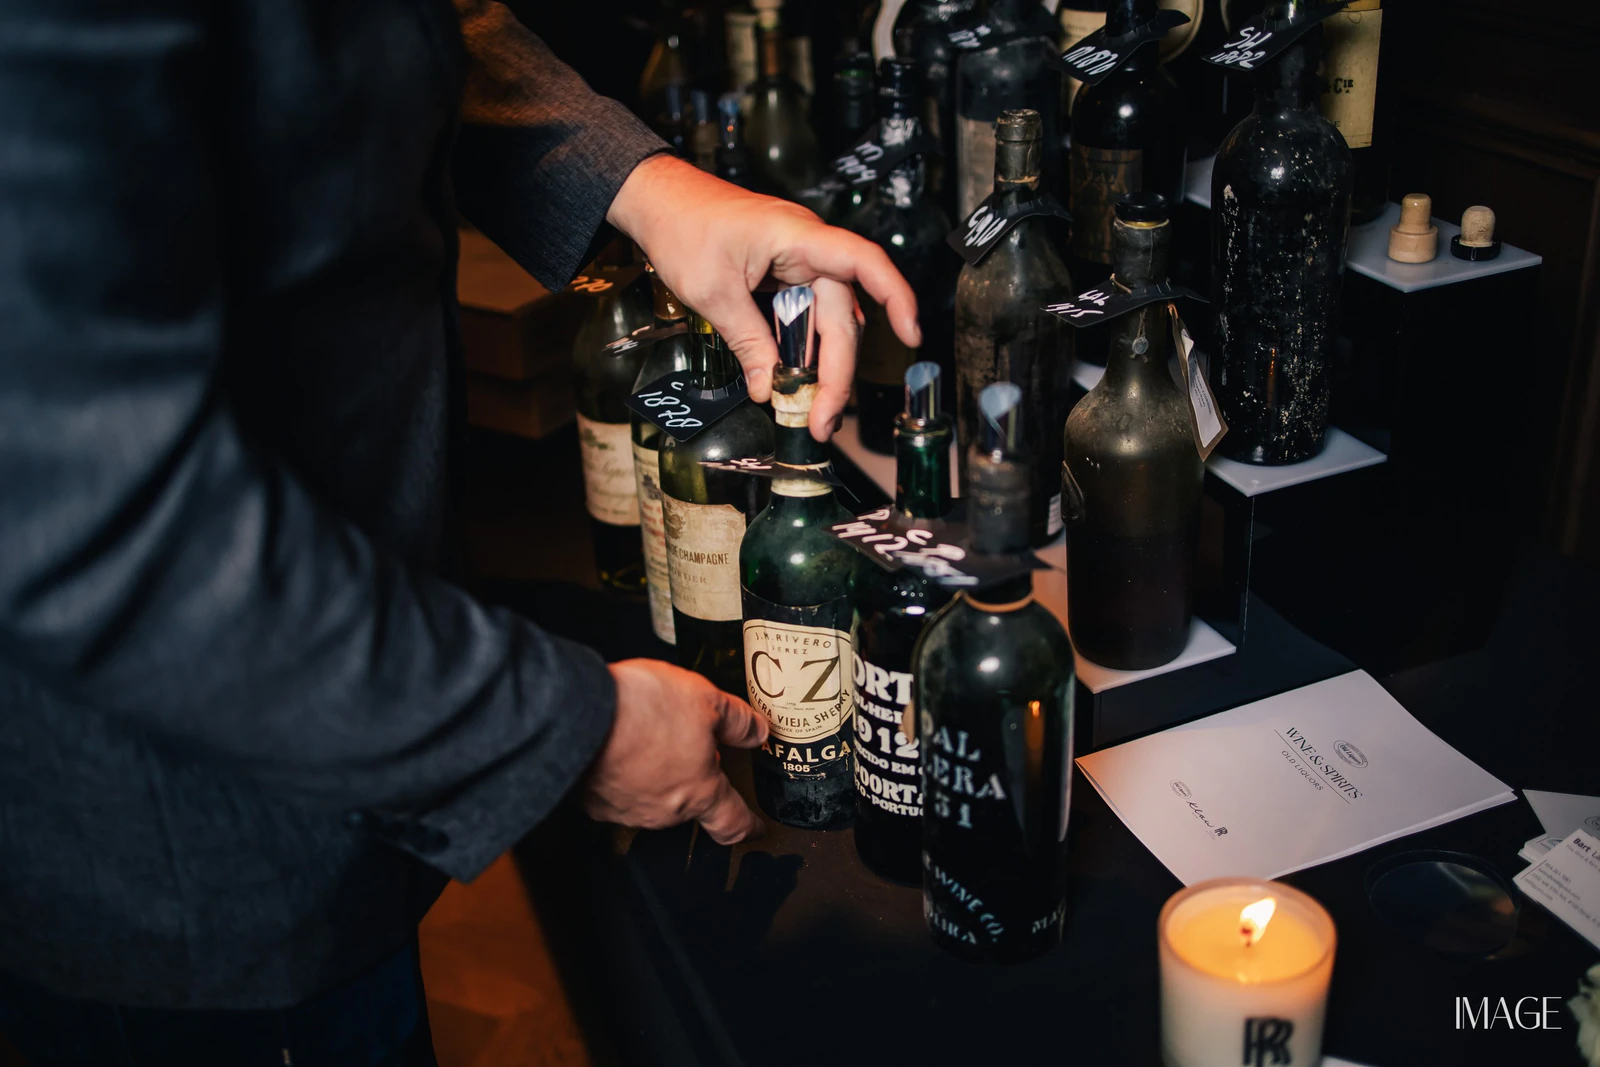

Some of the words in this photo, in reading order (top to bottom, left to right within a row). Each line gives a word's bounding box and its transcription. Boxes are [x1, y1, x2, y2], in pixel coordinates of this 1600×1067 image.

[678, 548, 730, 565] CHAMPAGNE
[777, 714, 810, 728] VIEJA
[814, 688, 851, 724] SHERRY
[782, 761, 811, 773] 1805
[1281, 750, 1296, 764] OLD
[1294, 764, 1324, 791] LIQUORS
[1286, 727, 1317, 756] WINE
[1309, 755, 1324, 766] &
[1320, 764, 1363, 799] SPIRITS
[1573, 837, 1591, 853] Bart
